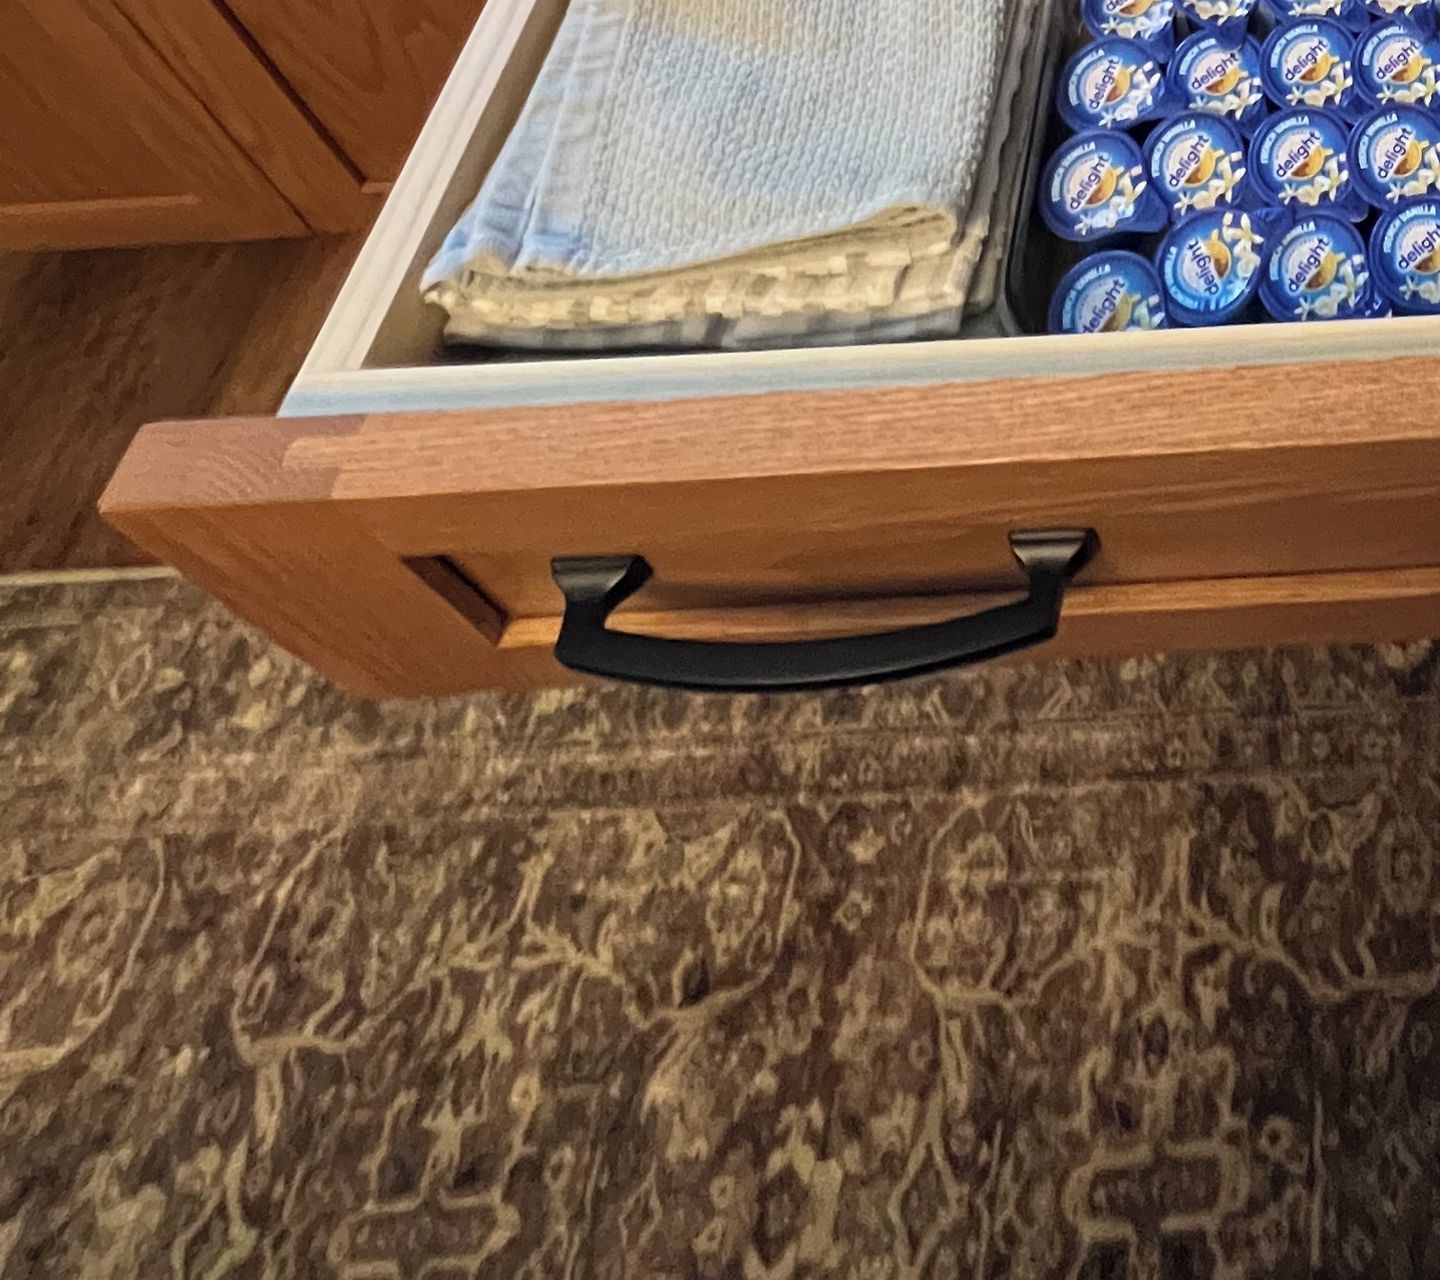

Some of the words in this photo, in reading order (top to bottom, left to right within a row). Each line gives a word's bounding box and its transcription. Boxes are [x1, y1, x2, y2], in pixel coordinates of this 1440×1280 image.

[1088, 57, 1120, 110] delight
[1191, 52, 1239, 90] delight
[1285, 39, 1328, 81] delight
[1376, 40, 1421, 80] delight
[1168, 134, 1210, 187] delight
[1276, 130, 1321, 178] delight
[1377, 127, 1414, 179] delight
[1070, 154, 1109, 210] delight
[1399, 204, 1436, 222] VANILLA
[1188, 239, 1220, 296] delight
[1288, 236, 1331, 293] delight
